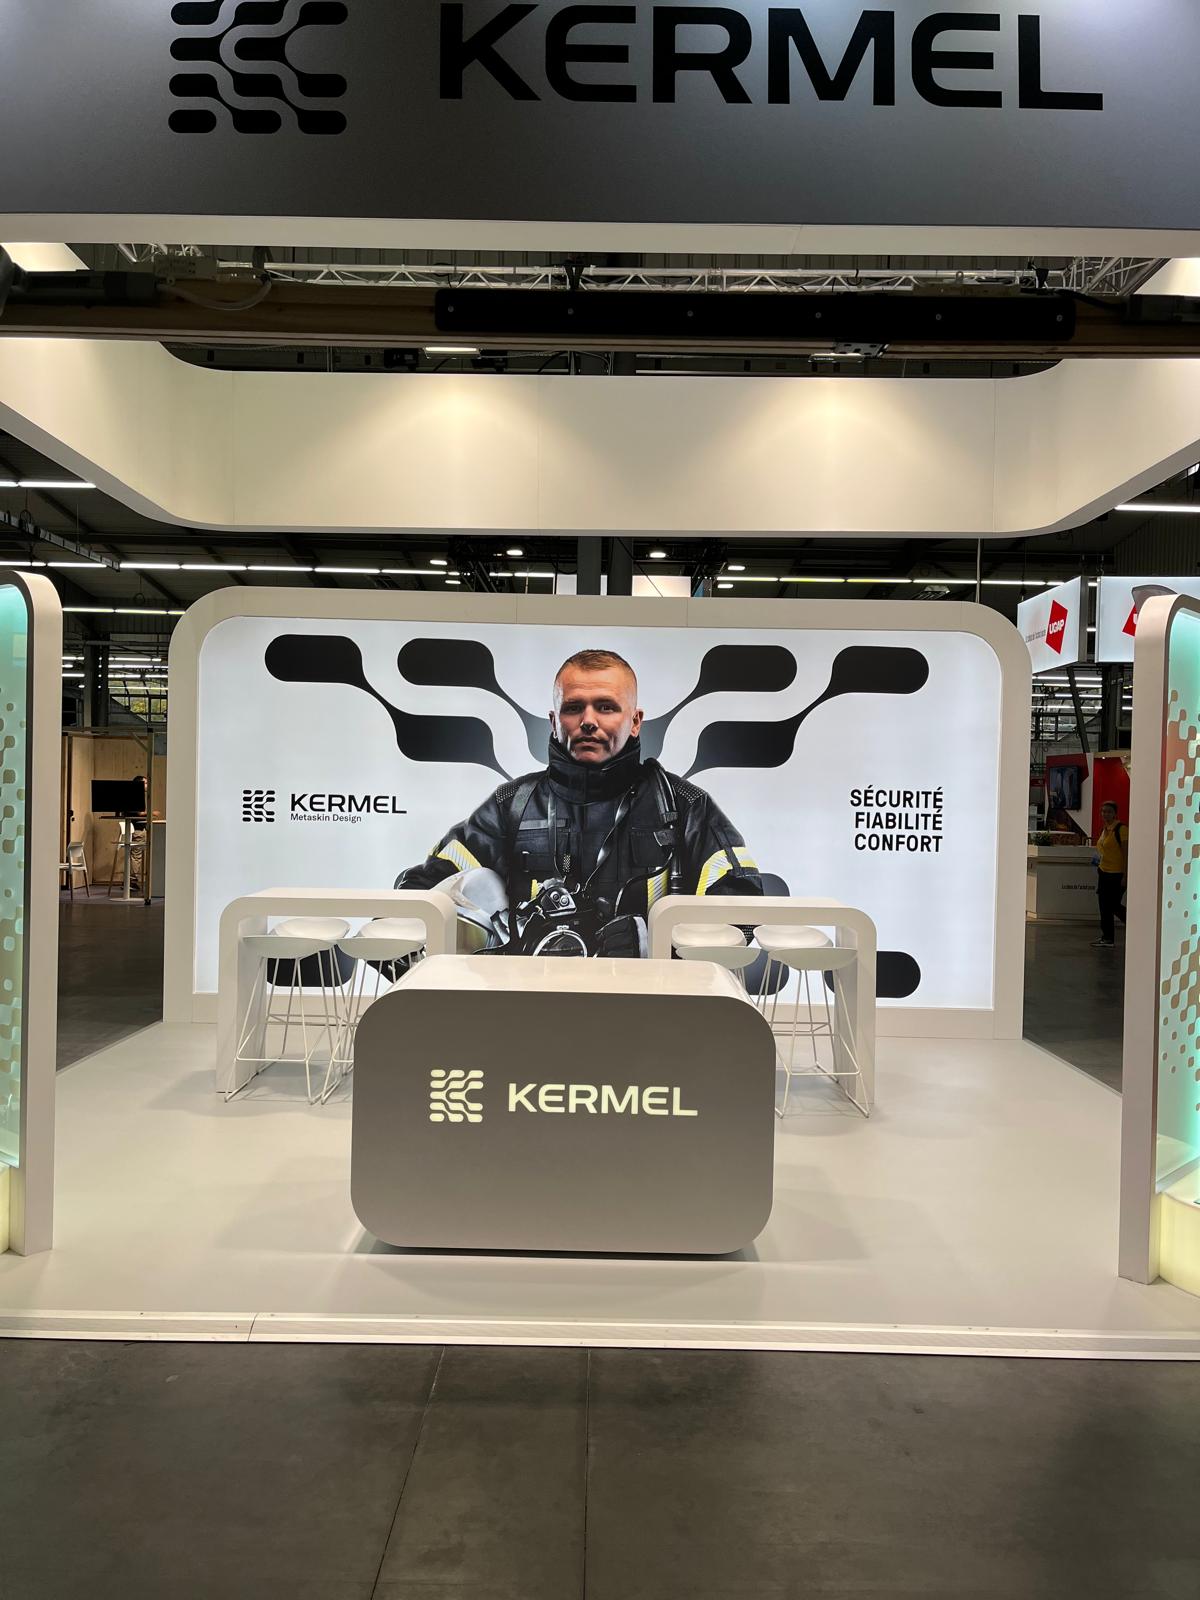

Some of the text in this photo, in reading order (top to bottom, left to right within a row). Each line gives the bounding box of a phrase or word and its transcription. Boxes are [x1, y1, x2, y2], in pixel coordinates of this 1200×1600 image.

[439, 3, 1103, 111] KERMEL
[291, 794, 407, 814] KERMEL
[850, 785, 943, 808] SÉCURITÉ
[291, 813, 362, 823] Metaskin Design
[855, 809, 942, 830] FIABILITÉ
[854, 833, 943, 852] CONFORT
[508, 1082, 698, 1116] KERMEL
